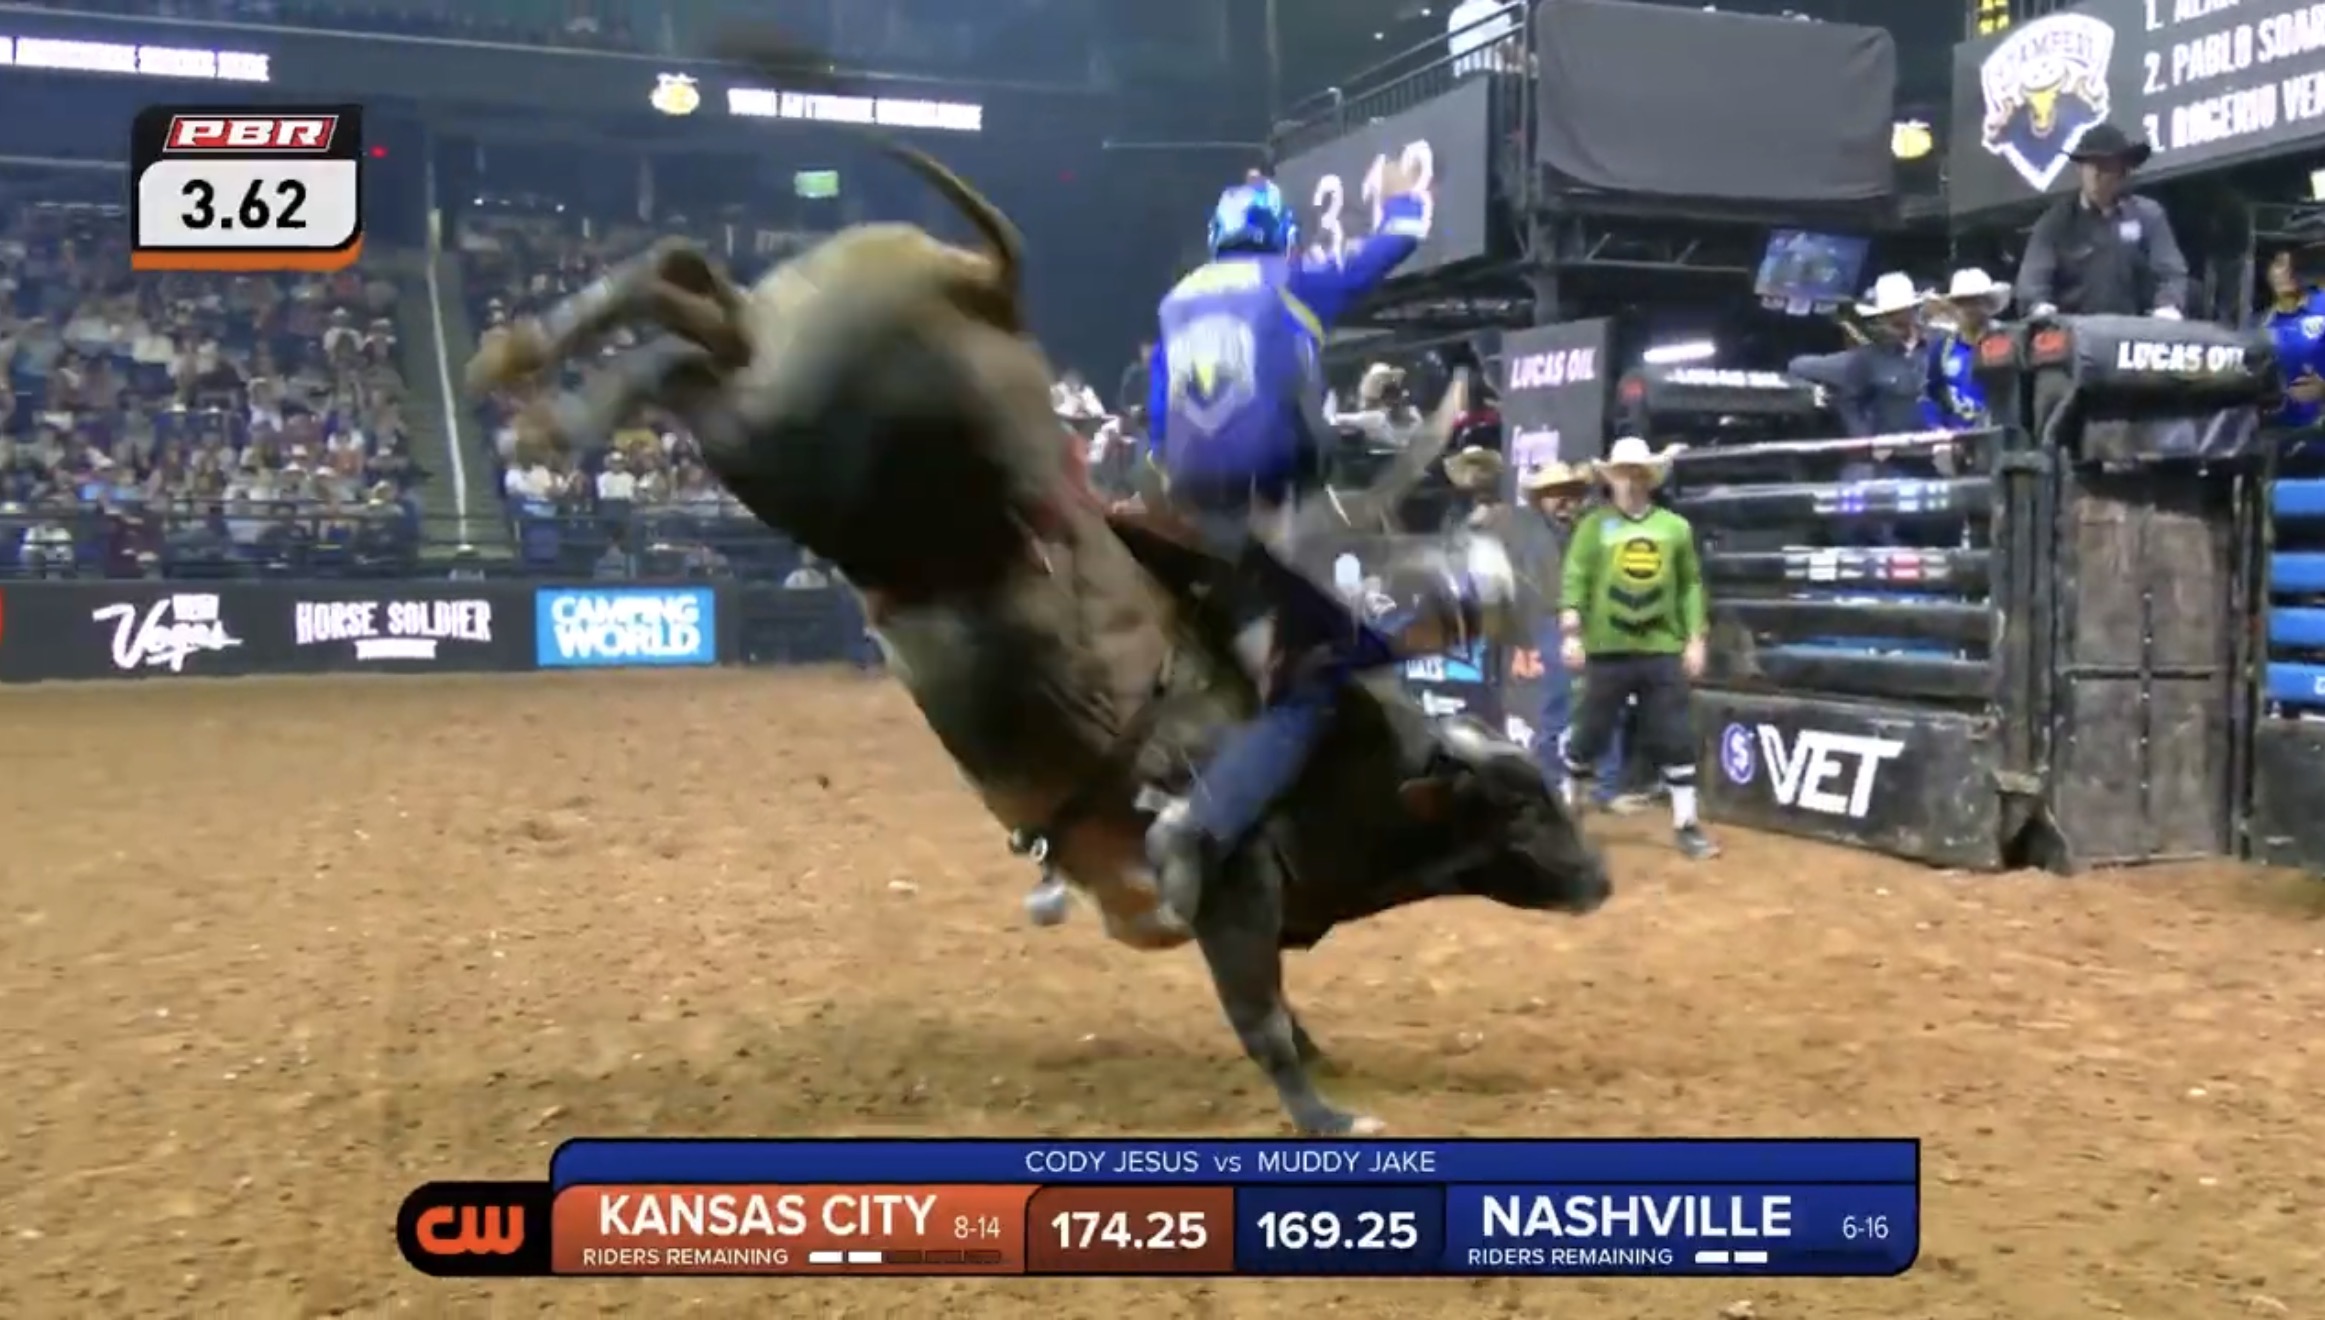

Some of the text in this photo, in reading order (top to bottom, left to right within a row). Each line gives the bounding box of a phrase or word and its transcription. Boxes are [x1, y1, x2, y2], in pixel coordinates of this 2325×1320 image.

[2143, 52, 2167, 95] 2.
[2173, 25, 2252, 86] PABLO
[1510, 347, 1597, 390] LUCAS OIL
[2117, 341, 2203, 371] LUCAS
[296, 599, 491, 644] HORSE SOLDIER
[552, 594, 699, 626] CAMPING
[554, 621, 701, 658] WORLD
[1757, 723, 1905, 819] VET
